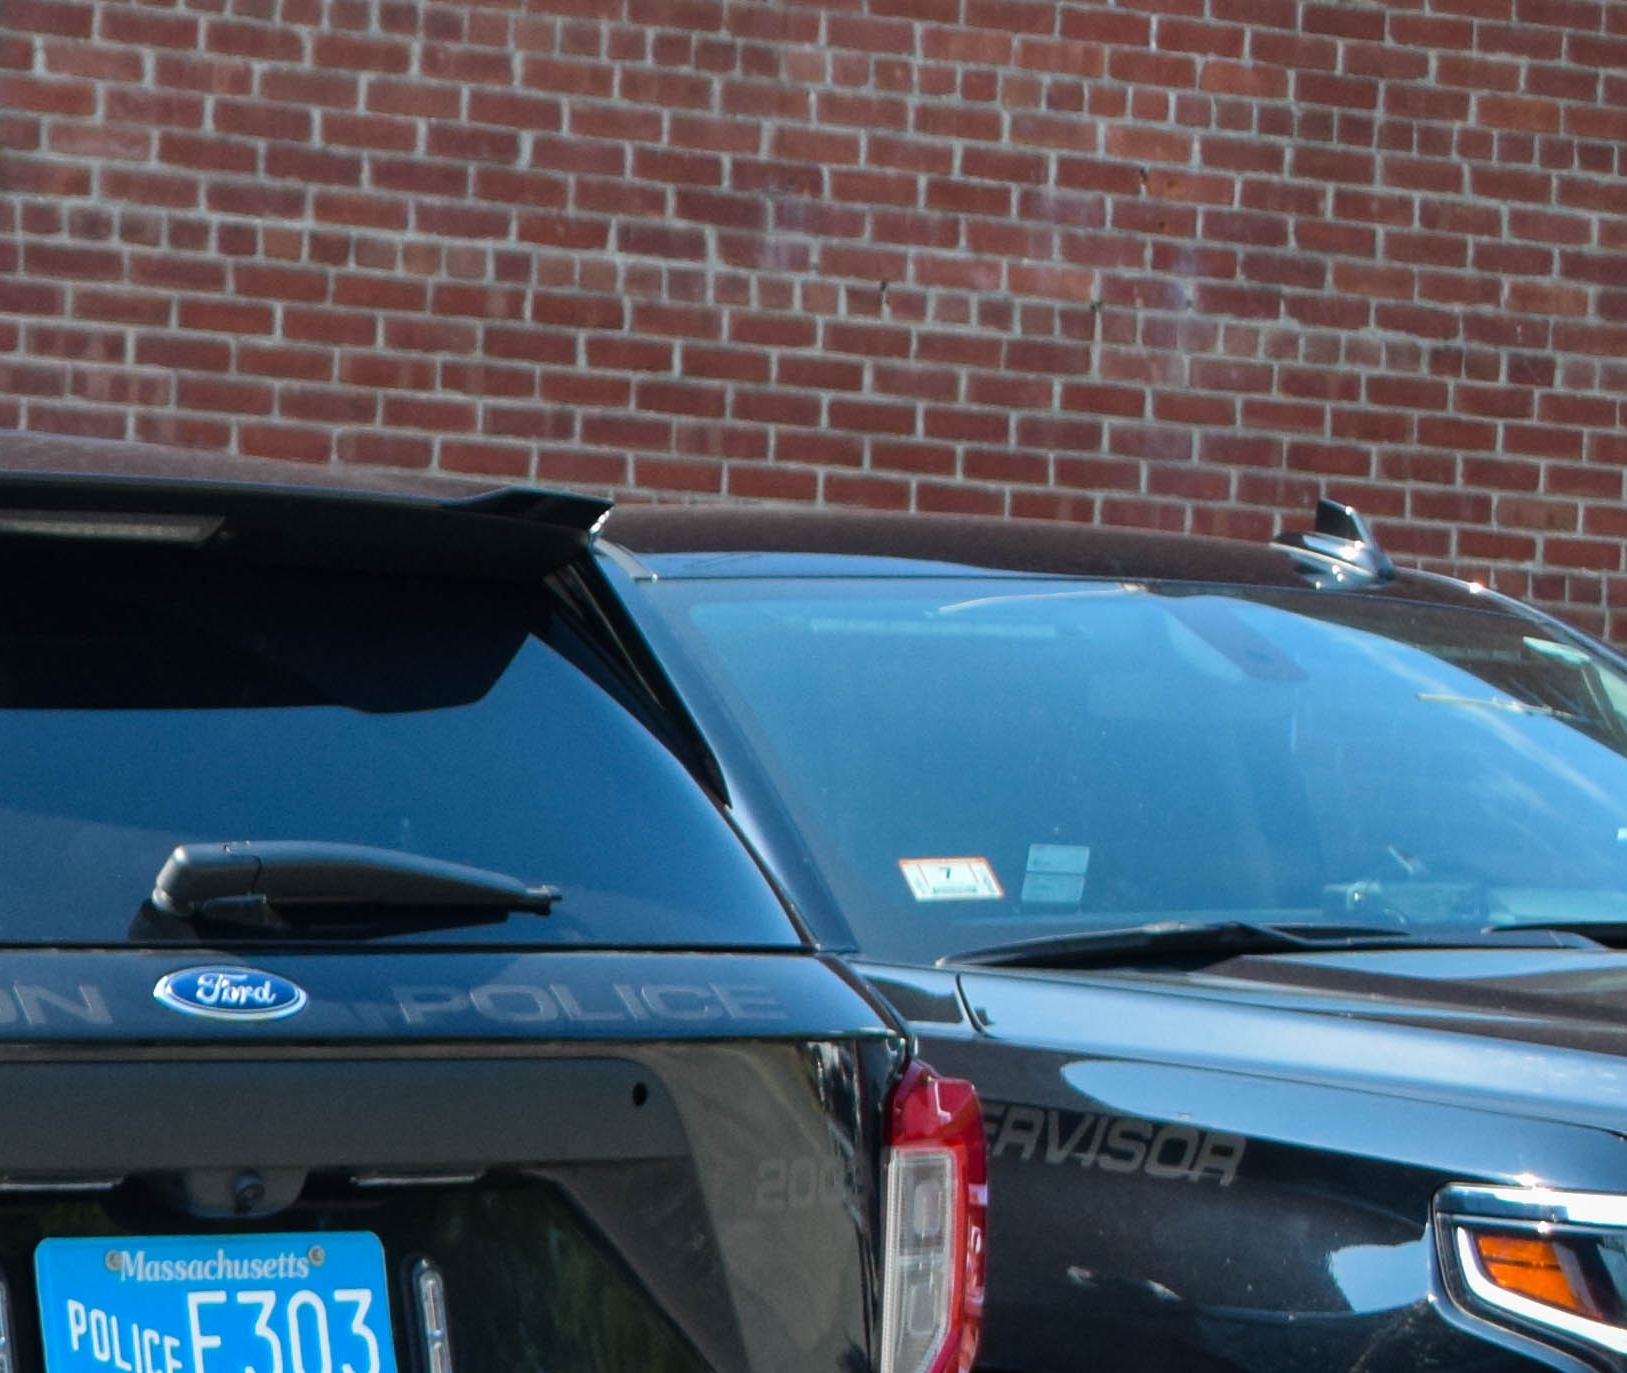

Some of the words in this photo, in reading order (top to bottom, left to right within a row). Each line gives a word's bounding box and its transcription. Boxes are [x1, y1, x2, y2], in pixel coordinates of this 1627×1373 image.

[195, 972, 277, 1006] Ford
[392, 983, 788, 1024] POLICE
[120, 1248, 309, 1282] Massachusetts
